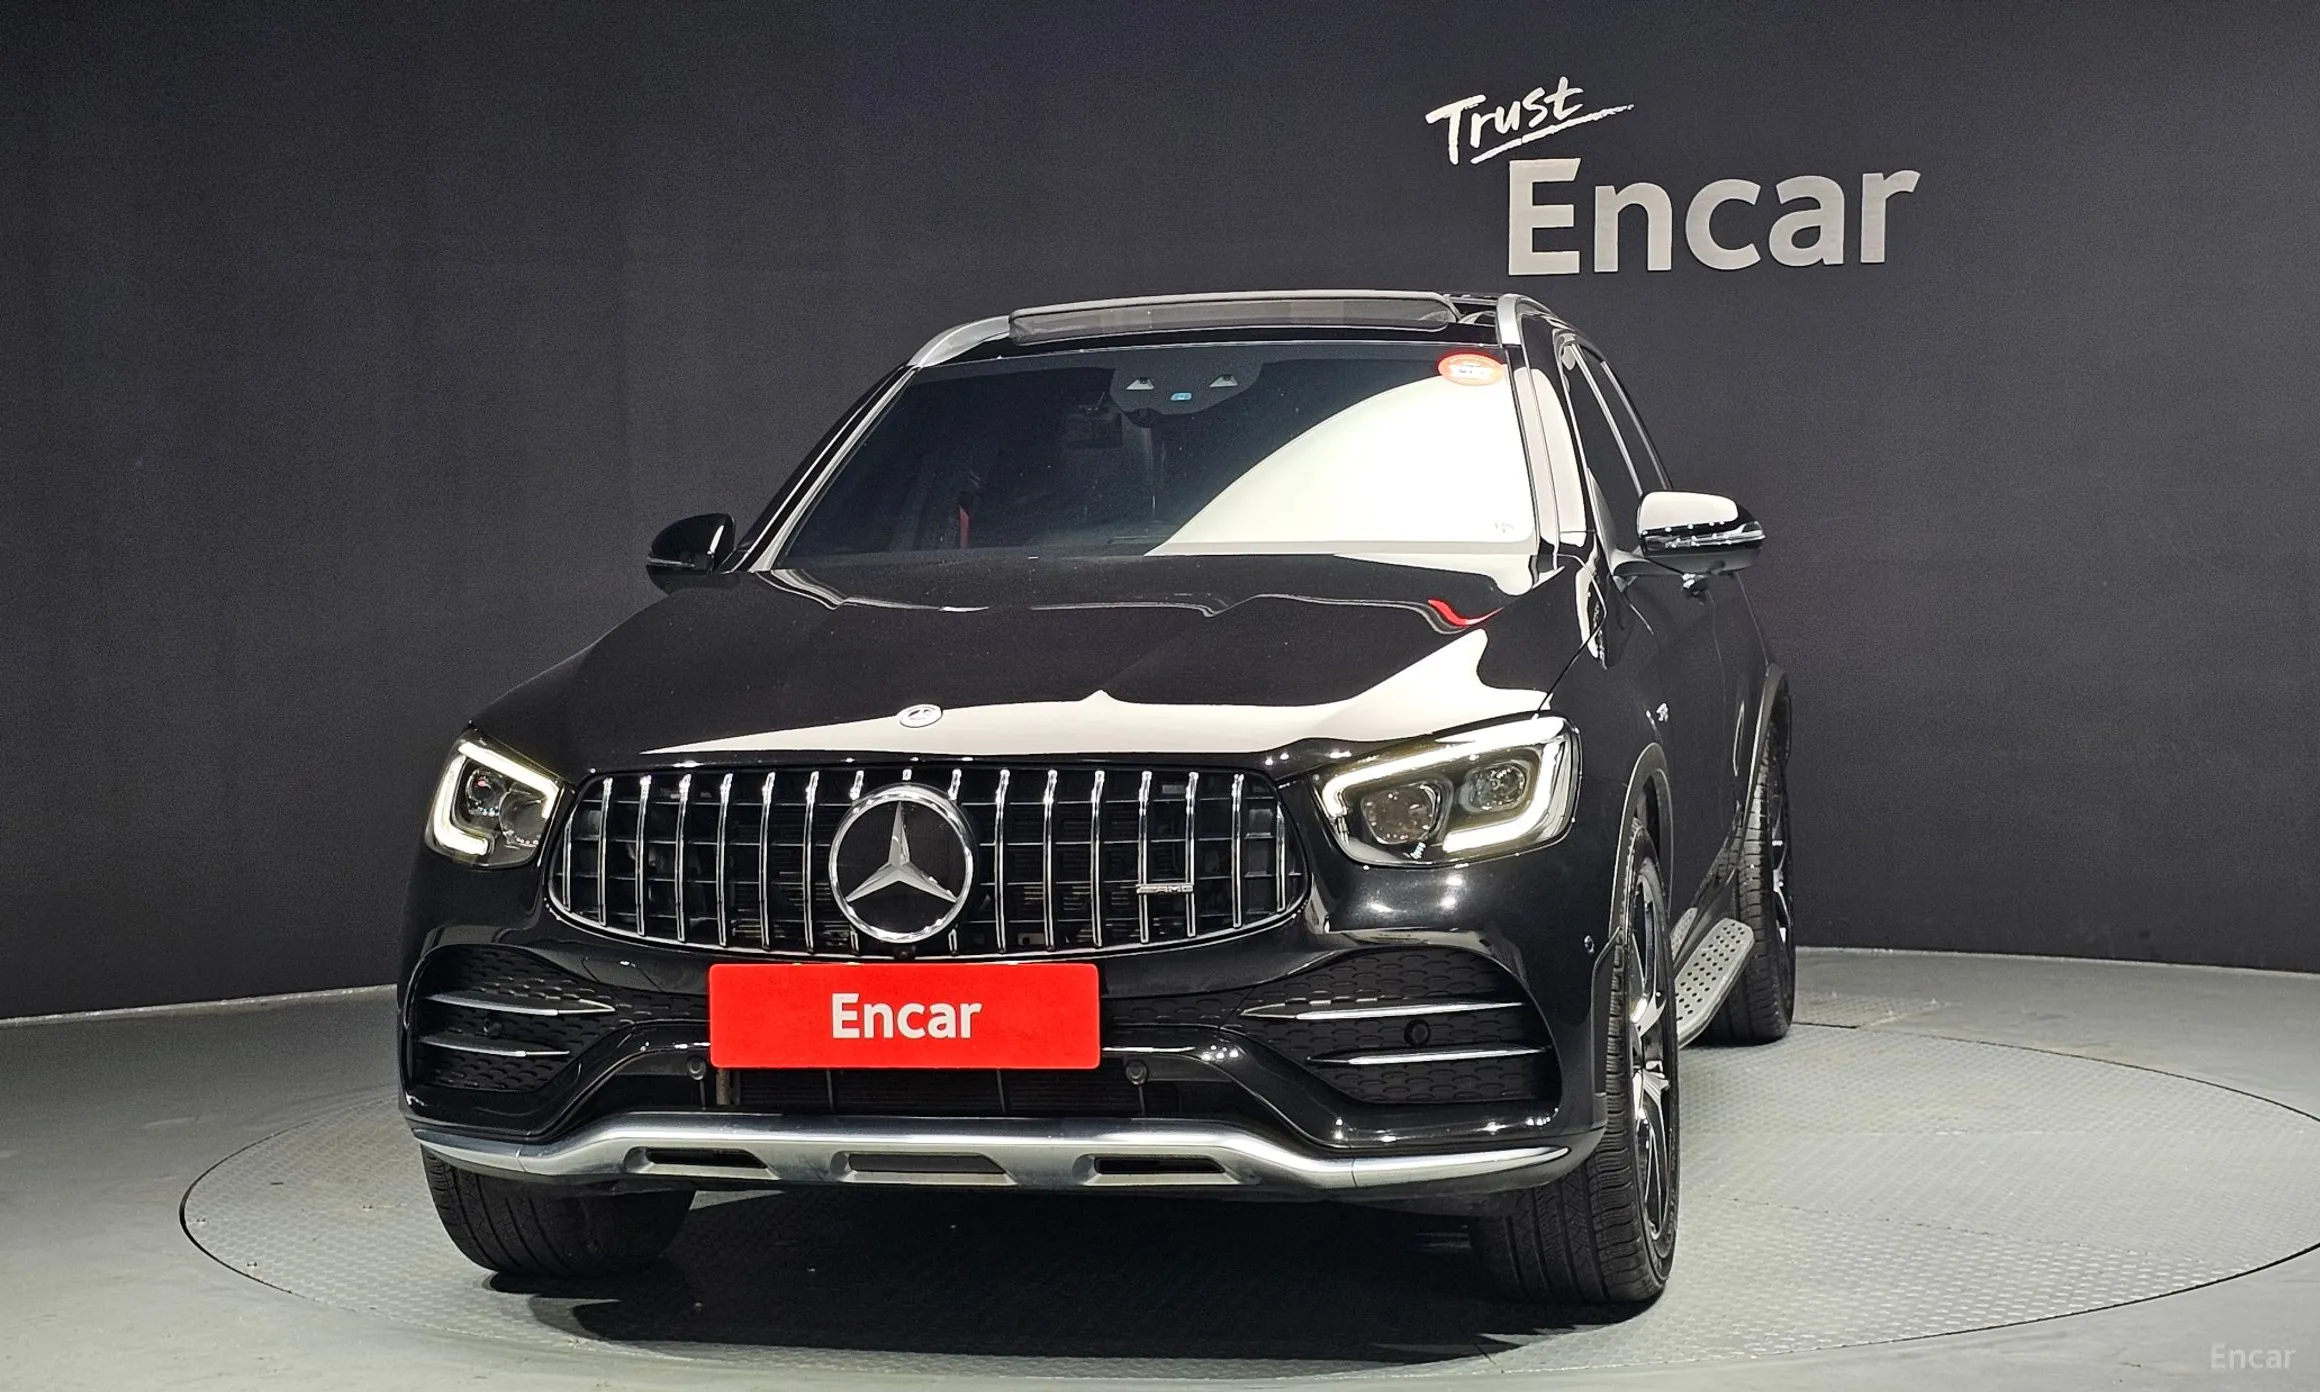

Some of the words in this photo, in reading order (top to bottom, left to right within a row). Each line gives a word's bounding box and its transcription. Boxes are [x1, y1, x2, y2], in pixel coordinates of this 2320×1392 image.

[1426, 76, 1584, 164] Trust
[1508, 157, 1921, 275] Encar
[831, 993, 982, 1039] Encar
